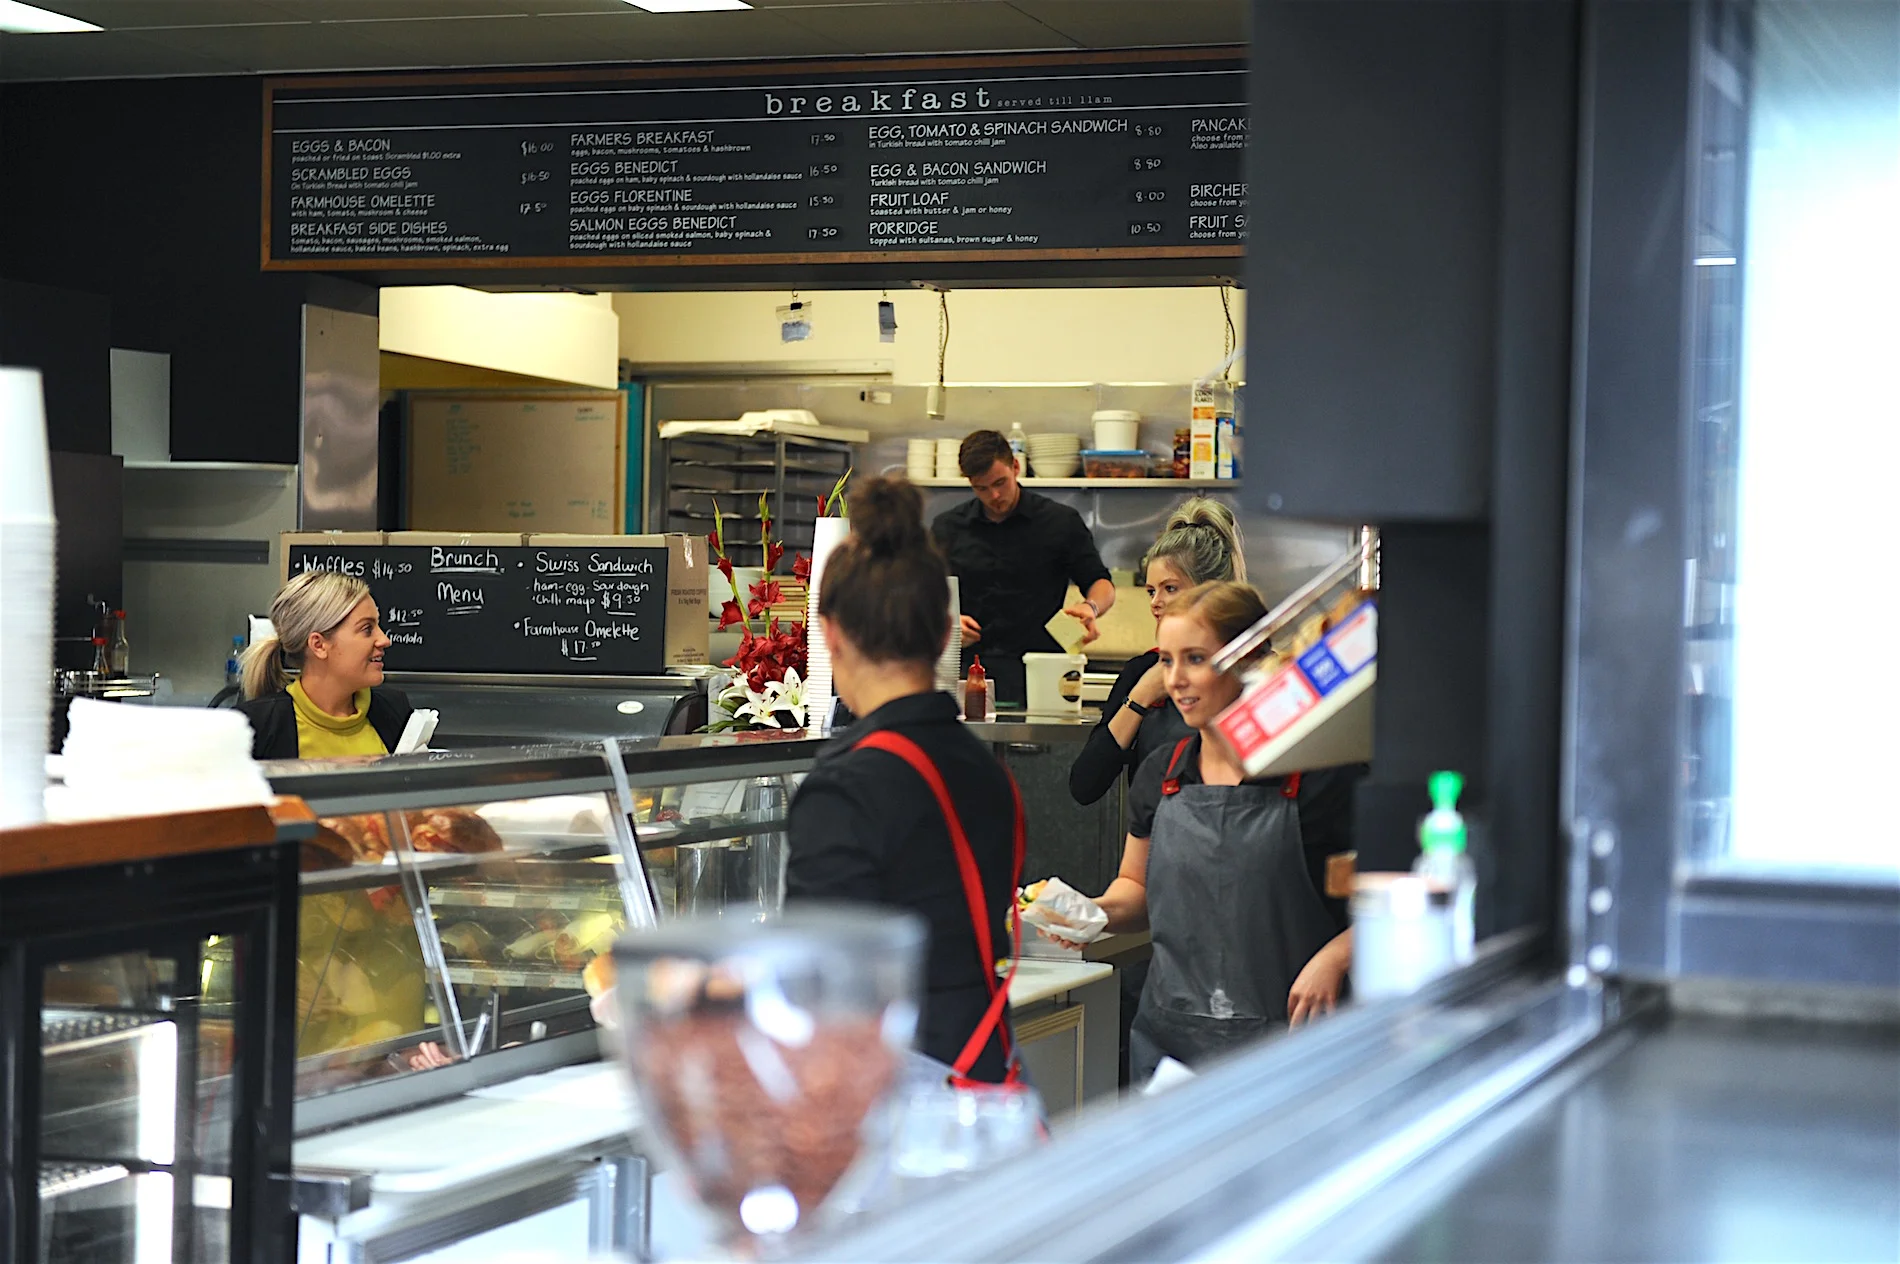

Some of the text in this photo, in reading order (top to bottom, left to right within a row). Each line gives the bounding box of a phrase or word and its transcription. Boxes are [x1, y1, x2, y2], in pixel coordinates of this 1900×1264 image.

[764, 87, 990, 114] breakfast
[997, 97, 1042, 107] served
[1048, 96, 1072, 106] till
[868, 119, 1128, 140] EGG, TOMATO & SPINACH SANDWICH
[570, 130, 715, 146] FARMERS BREAKFAST
[878, 140, 904, 148] Turkish
[992, 138, 1006, 148] jam
[292, 139, 390, 153] EGGS & BACON
[292, 166, 411, 181] SCRAMBLED EGGS
[570, 160, 678, 175] EGGS BENEDICT
[870, 160, 1048, 177] EGG & BACON SANDWICH
[984, 178, 999, 186] jam
[291, 194, 435, 208] FARMHOUSE OMELETTE
[570, 189, 692, 204] EGGS FLORENTINE
[870, 192, 949, 206] FRUIT LOAF
[1190, 199, 1217, 207] choose
[924, 206, 951, 214] butter
[960, 206, 976, 216] jam
[988, 206, 1012, 214] honey
[291, 222, 448, 236] BREAKFAST SIDE DISHES
[570, 216, 737, 232] SALMON EGGS BENEDICT
[870, 221, 938, 235] PORRIDGE
[1190, 215, 1228, 228] FRUIT
[870, 234, 1038, 246] topped with sultanas, brown sugar & honey
[1190, 230, 1236, 238] choose from
[304, 554, 365, 576] Waffles
[430, 547, 498, 568] Brunch
[536, 552, 654, 574] Swiss Sandwich
[438, 582, 484, 604] Menu
[566, 598, 596, 614] mayo
[524, 616, 640, 640] Farmhouse Omelette
